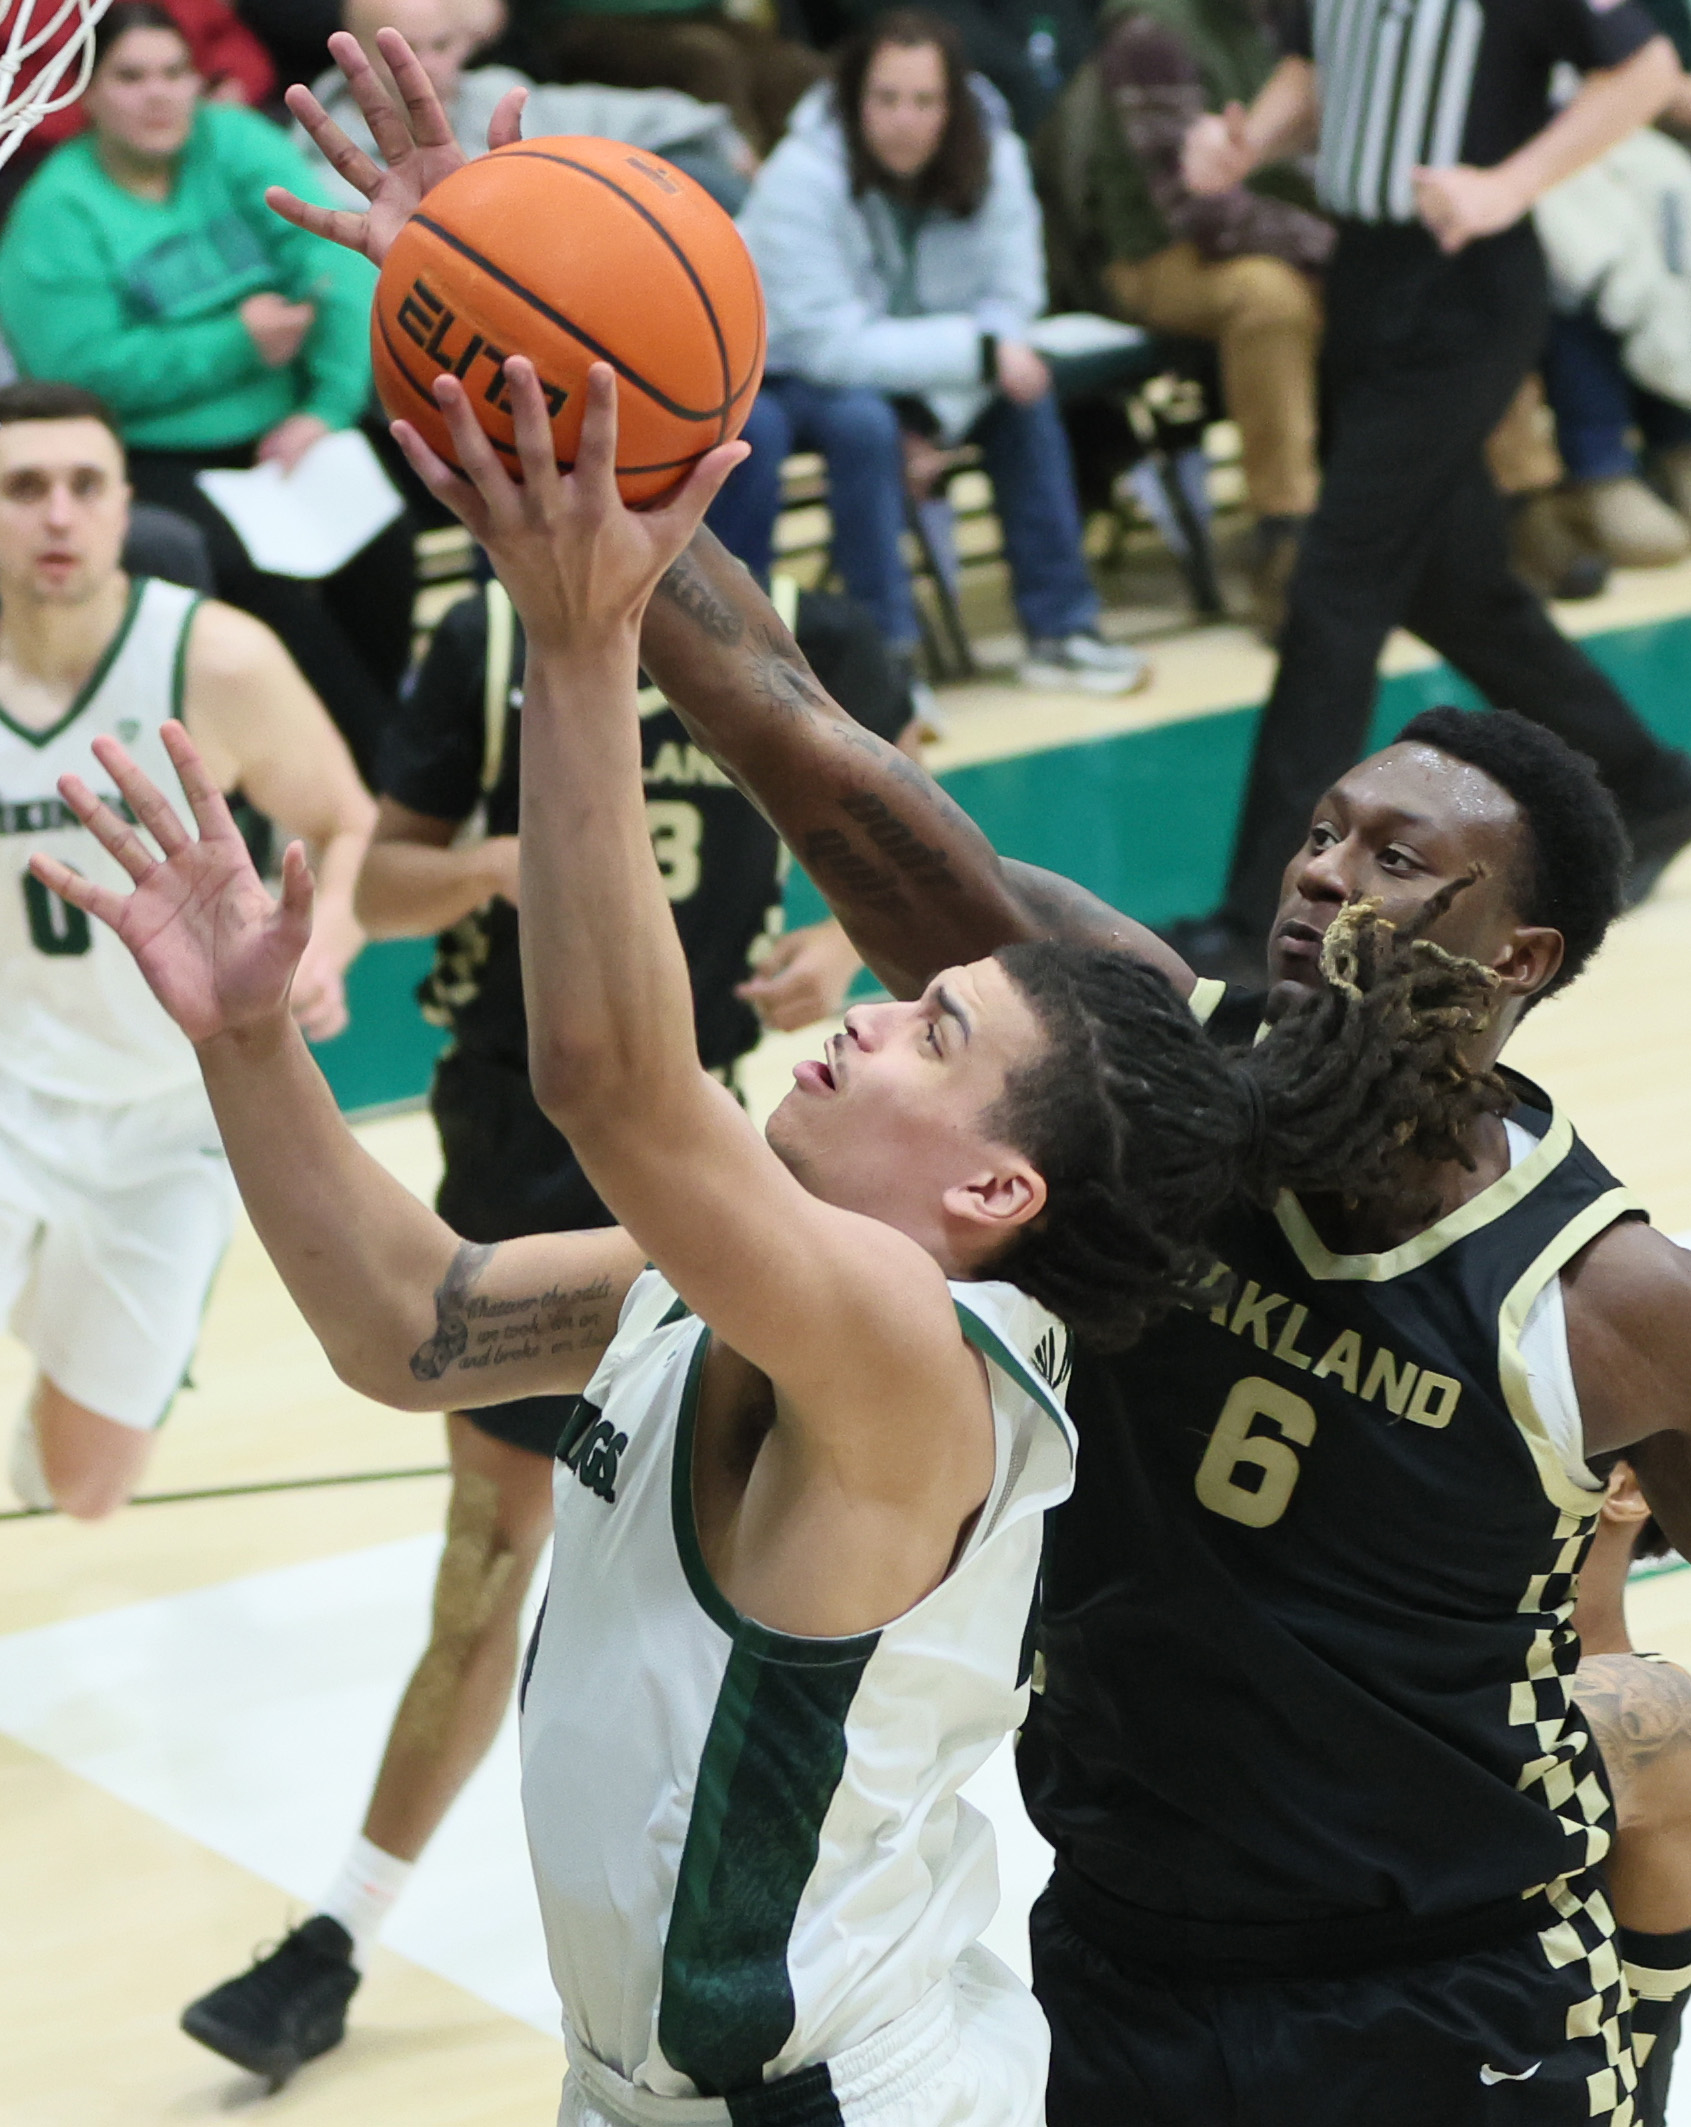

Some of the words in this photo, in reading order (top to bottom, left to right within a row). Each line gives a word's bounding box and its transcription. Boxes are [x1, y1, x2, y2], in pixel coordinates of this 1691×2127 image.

[22, 860, 92, 956] 0
[458, 1344, 493, 1370] and
[1194, 1376, 1318, 1528] 6
